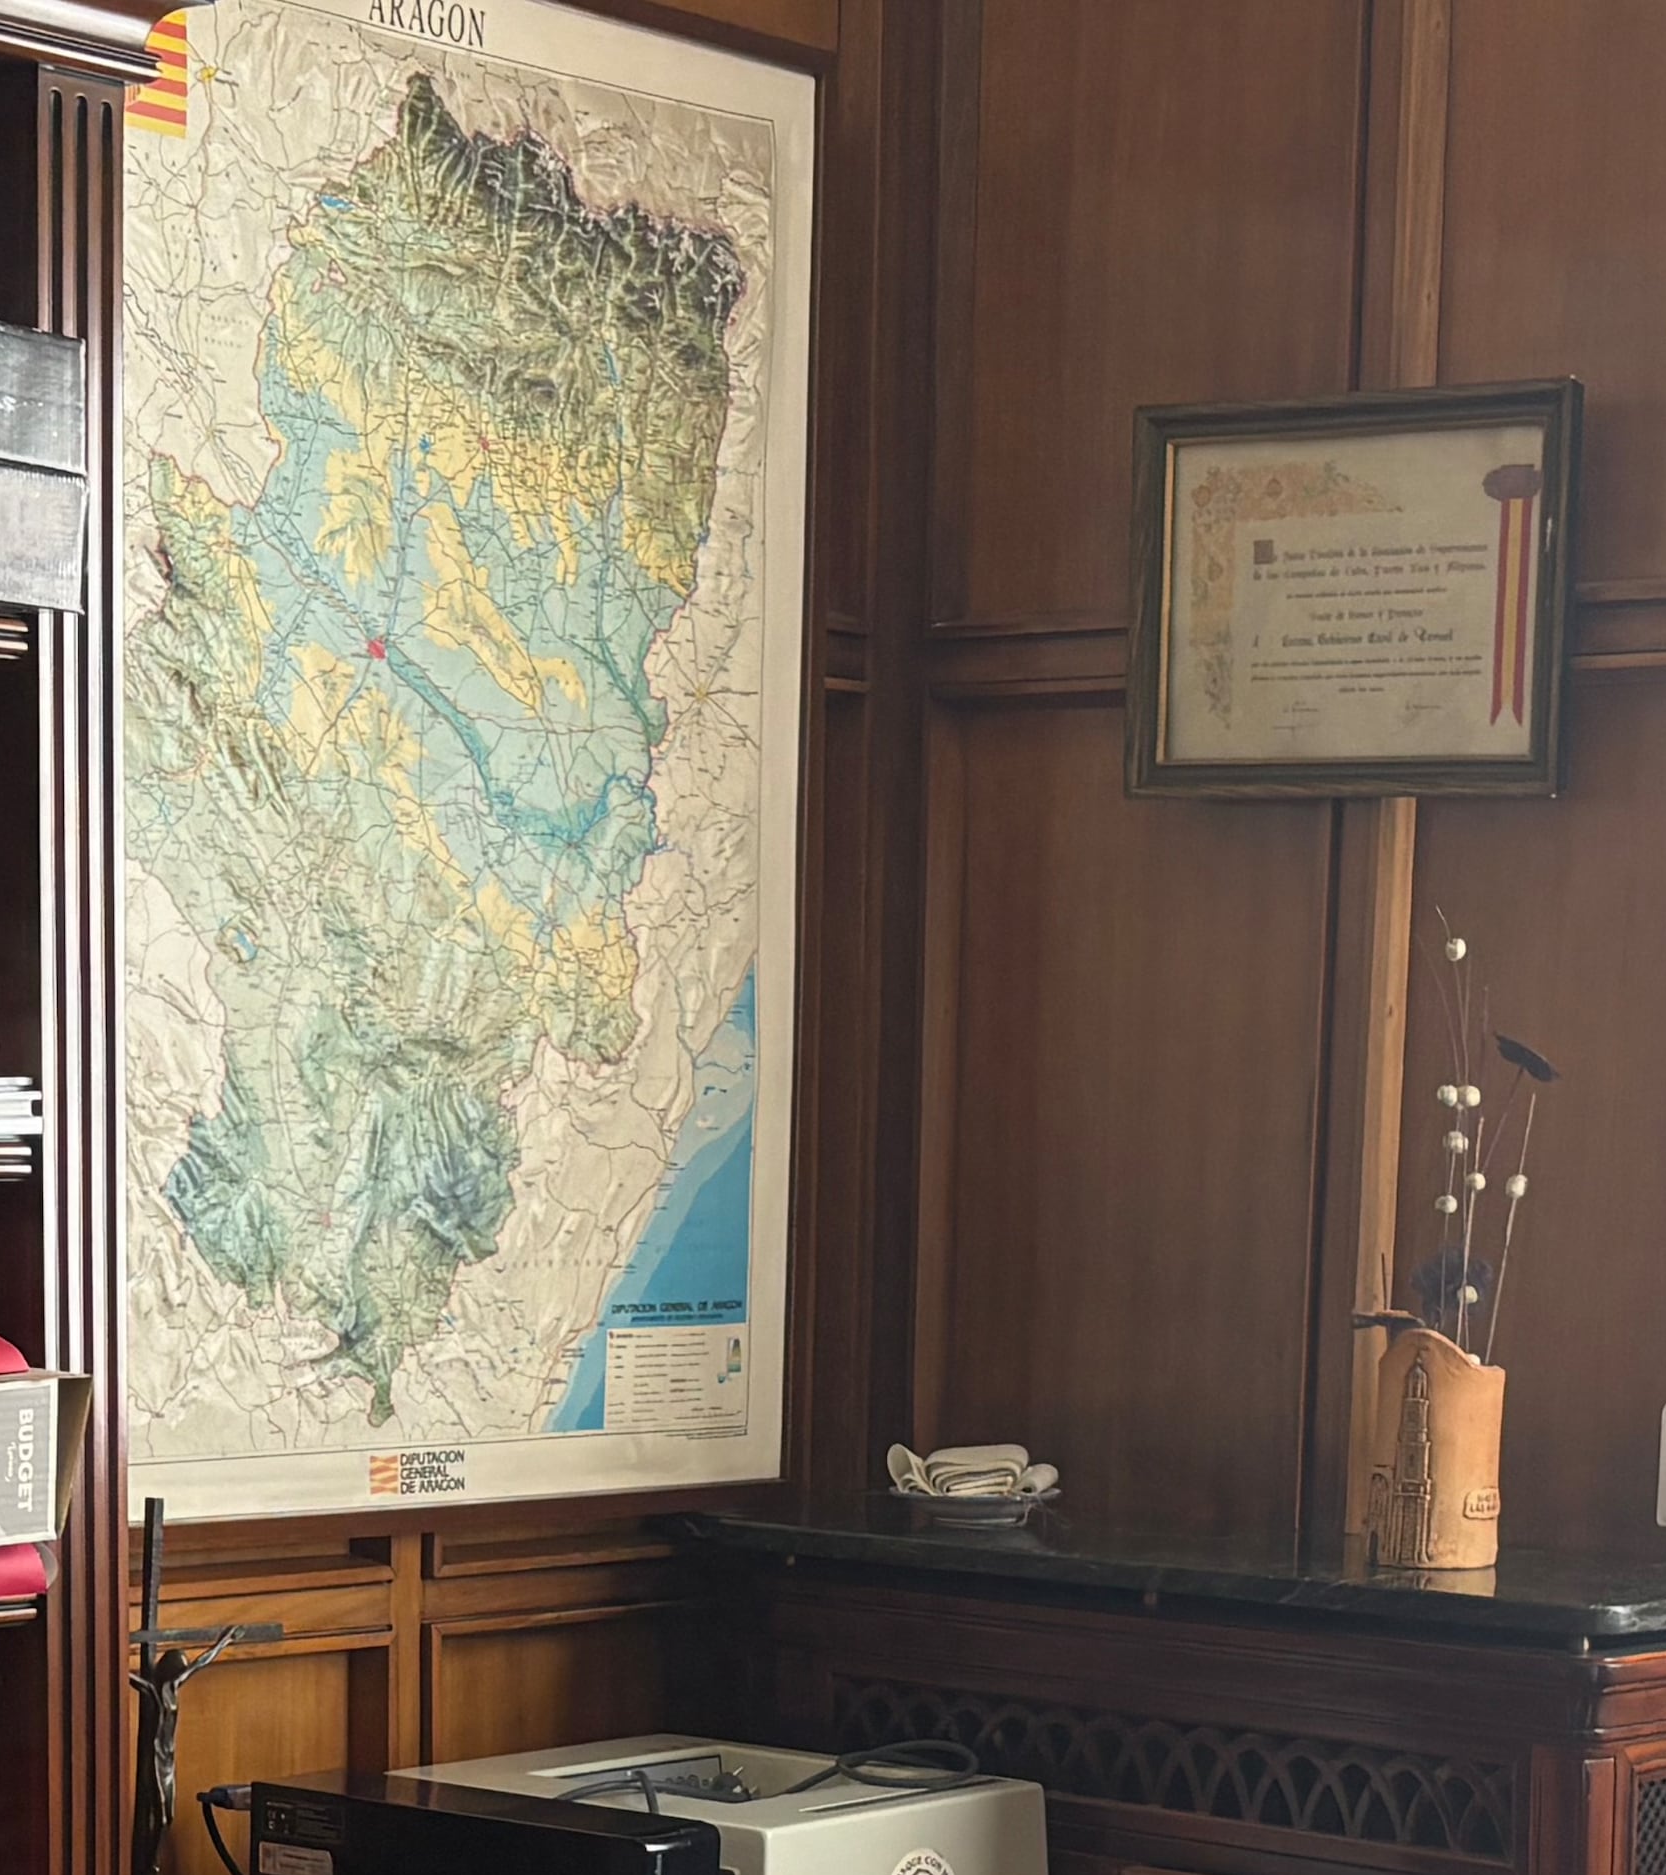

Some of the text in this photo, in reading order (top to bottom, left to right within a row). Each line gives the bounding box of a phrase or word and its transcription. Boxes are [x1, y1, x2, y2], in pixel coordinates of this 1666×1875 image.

[17, 1408, 34, 1513] BUDGET
[400, 1450, 465, 1466] DIPUTACION
[400, 1465, 450, 1480] GENERAL
[400, 1477, 466, 1495] DE ARAGON
[924, 1856, 942, 1872] CON
